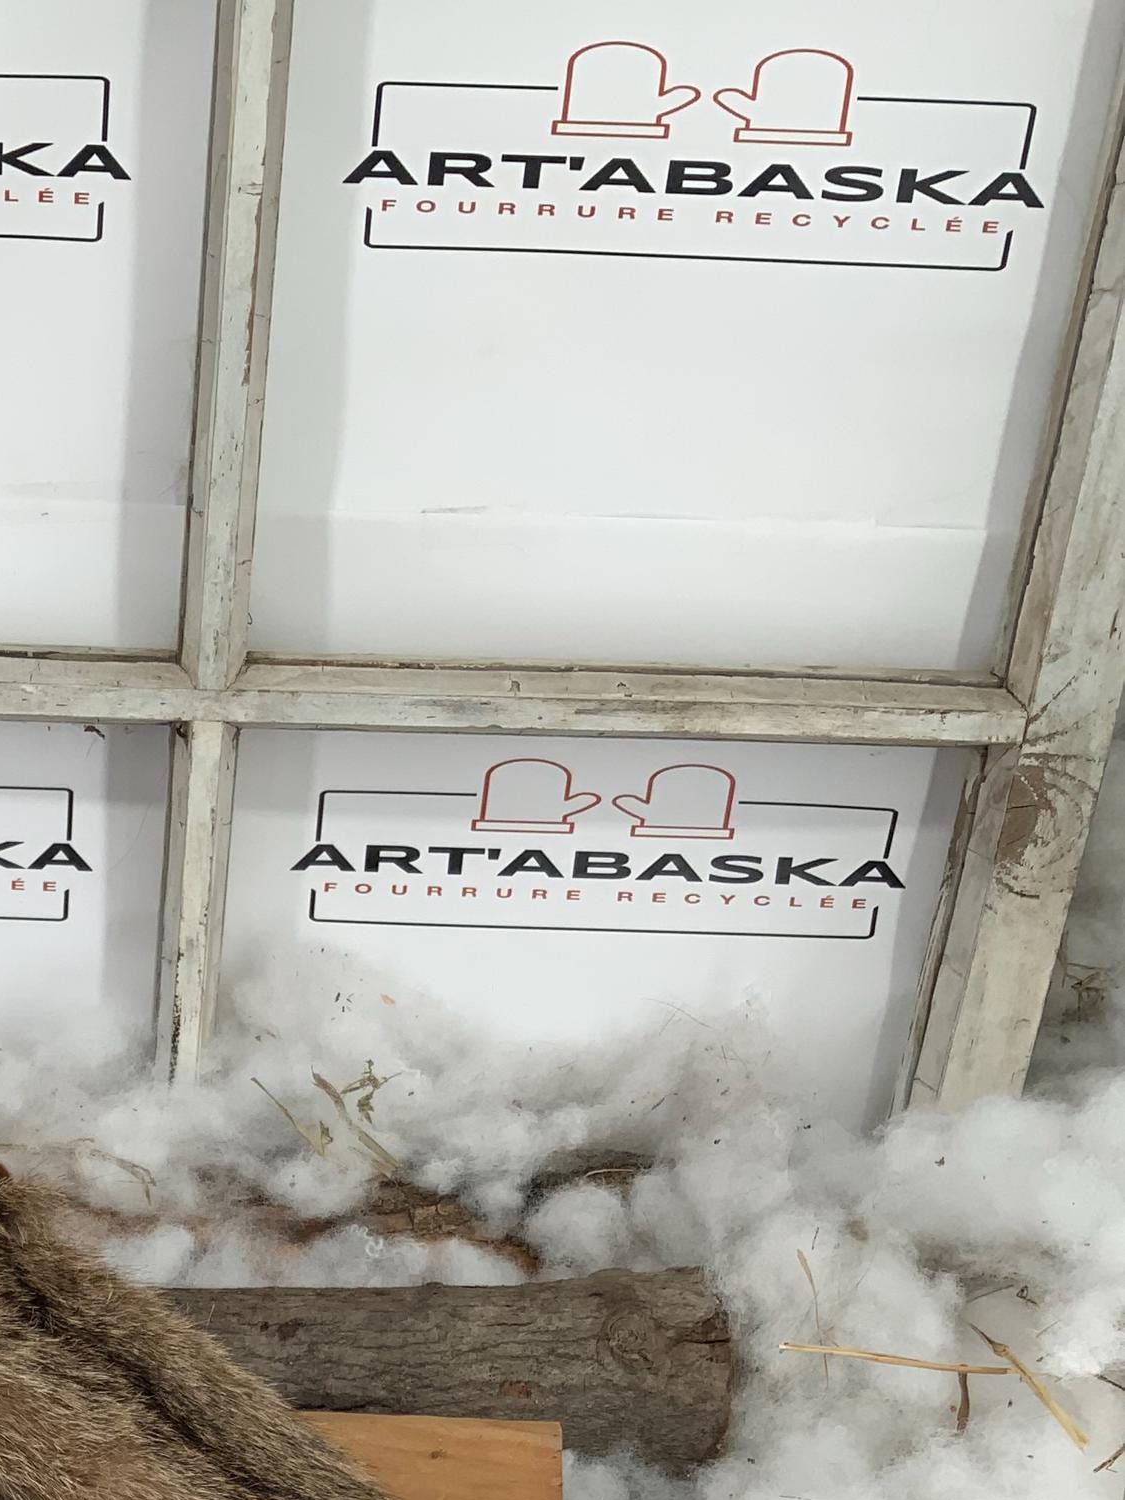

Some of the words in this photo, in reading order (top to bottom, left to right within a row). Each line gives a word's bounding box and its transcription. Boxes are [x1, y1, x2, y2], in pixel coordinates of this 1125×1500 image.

[342, 150, 1045, 216] ART'ABASKA
[381, 199, 674, 221] FOURRURE
[715, 211, 1000, 234] RECYCLÉE
[289, 844, 906, 896] ART'ABASKA
[324, 882, 581, 900] FOURRURE
[617, 891, 867, 909] RECYCLÉE
